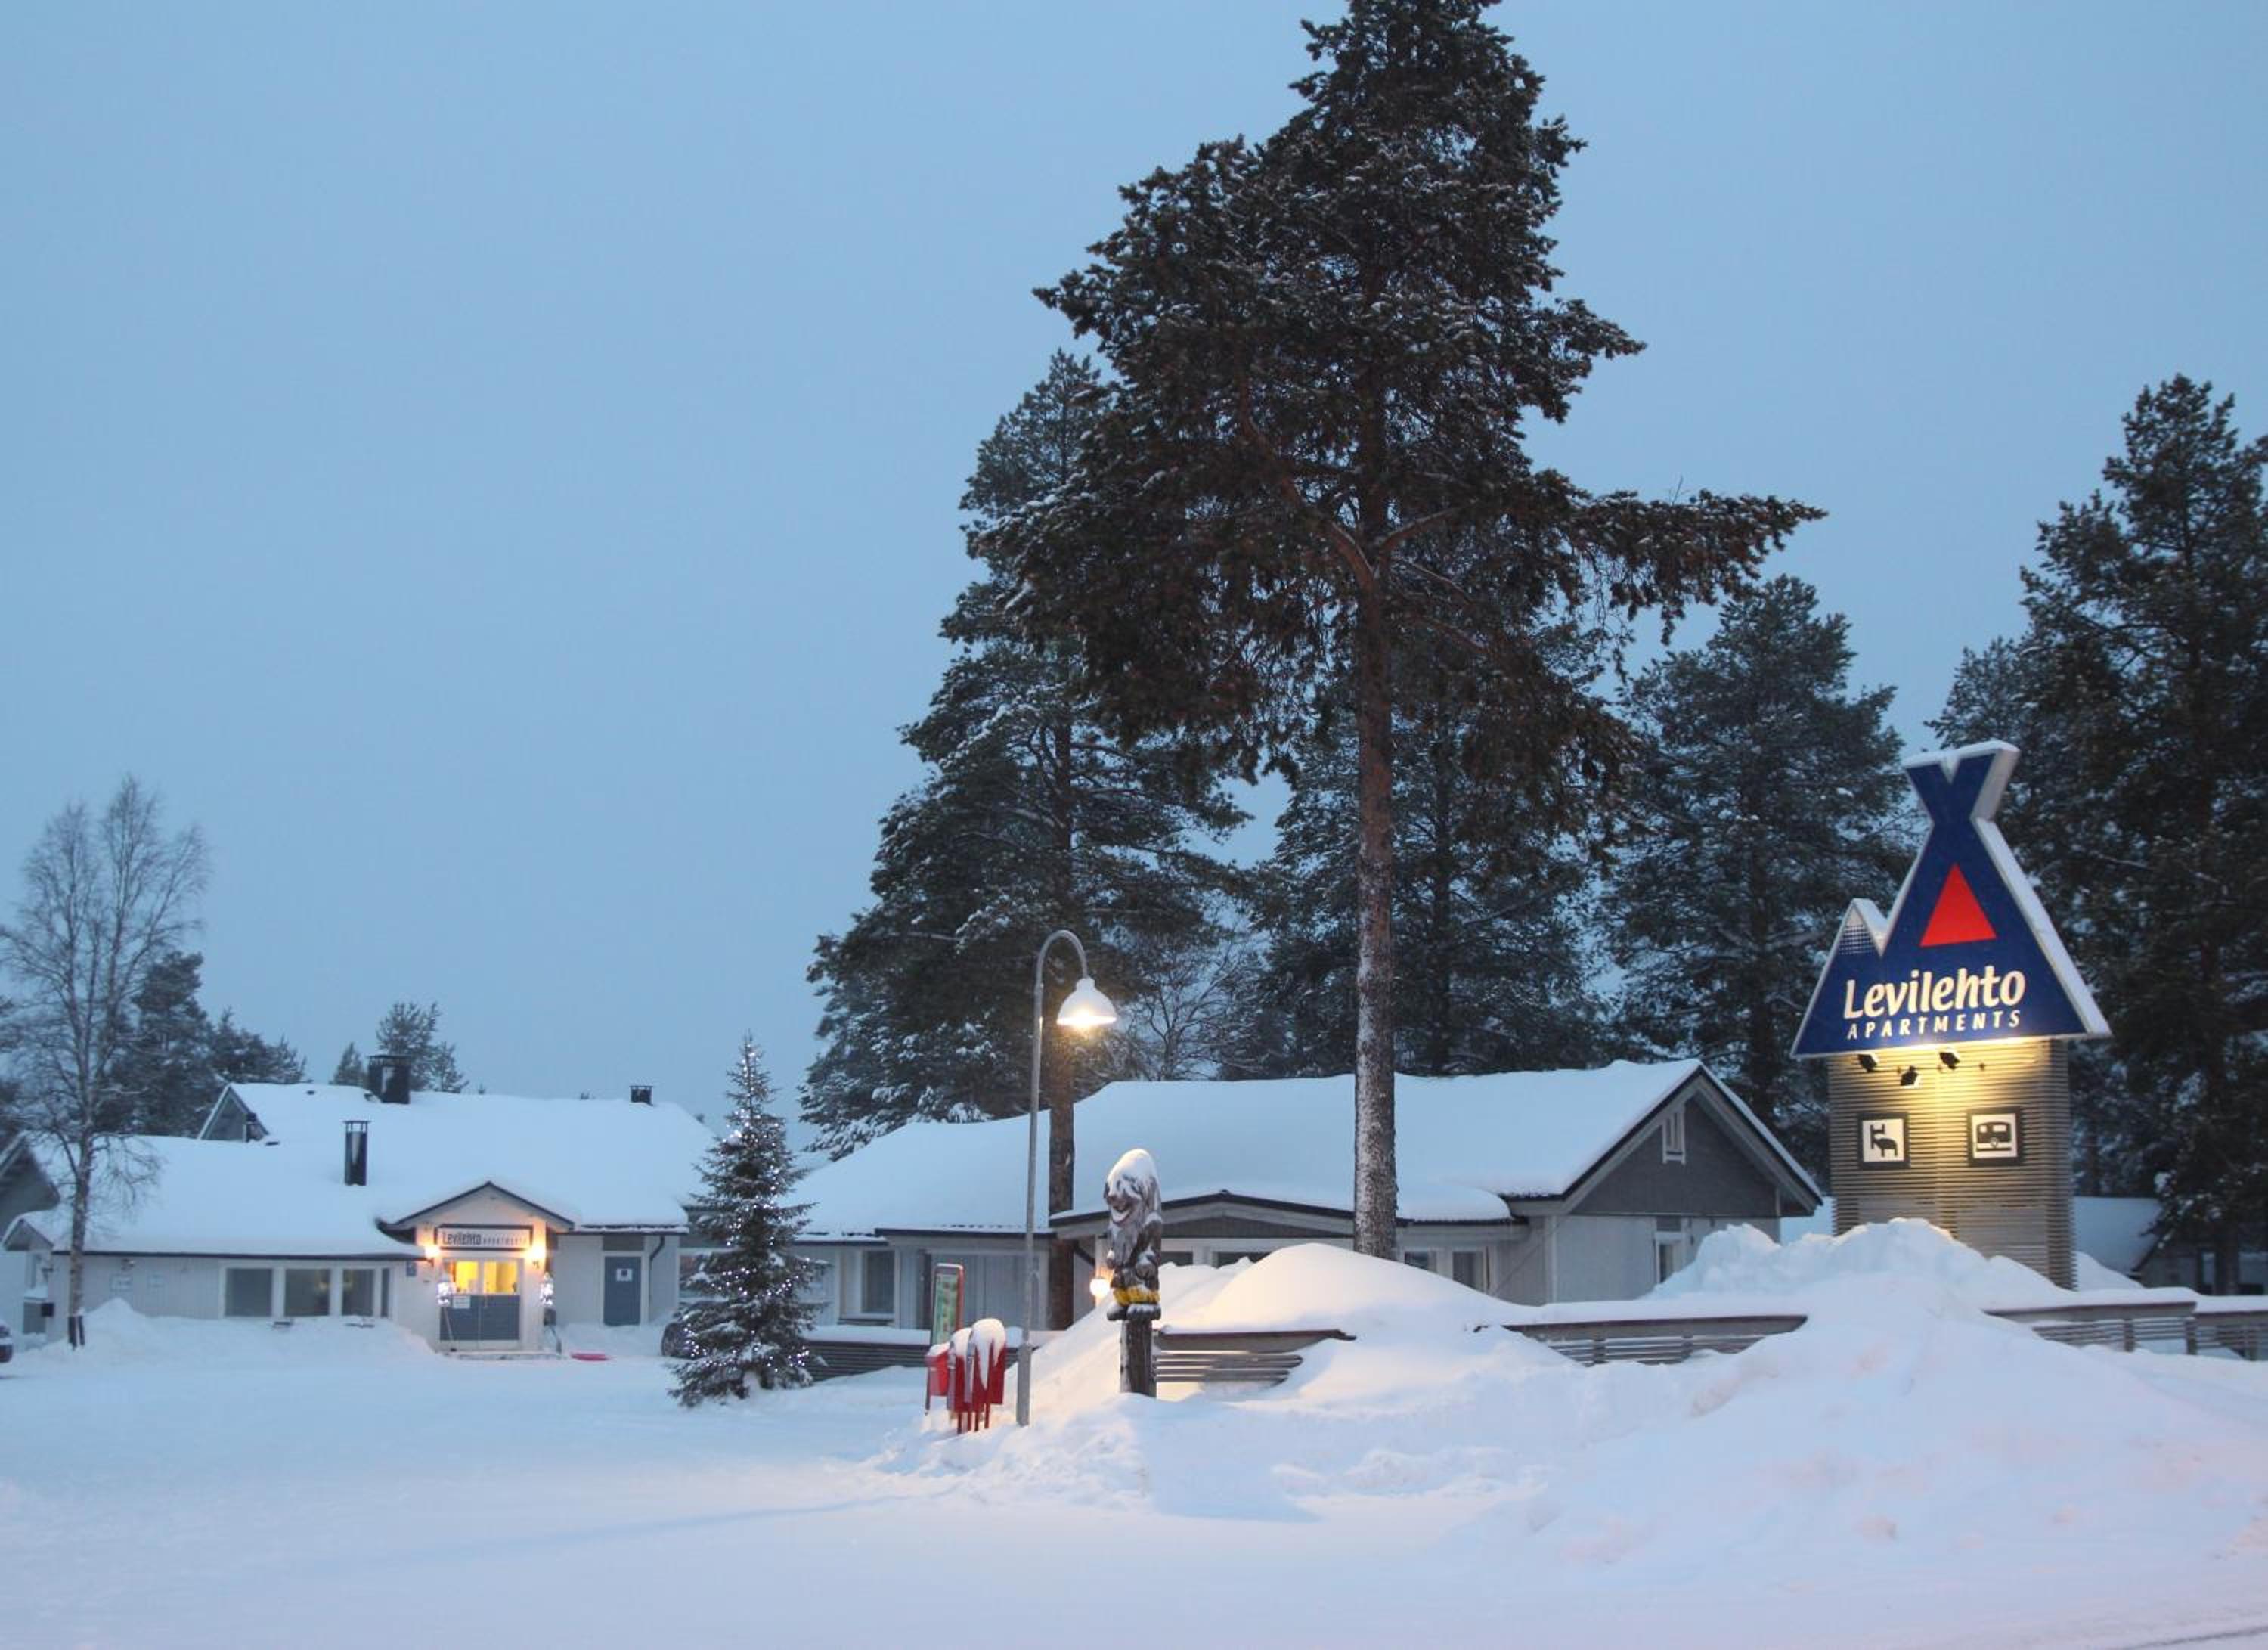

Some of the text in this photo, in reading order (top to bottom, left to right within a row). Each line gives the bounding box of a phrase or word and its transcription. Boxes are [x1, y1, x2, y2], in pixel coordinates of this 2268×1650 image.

[1844, 965, 2026, 1019] Levilehto
[1847, 1010, 2021, 1040] APARTMENTS
[442, 1232, 482, 1245] Levilehto
